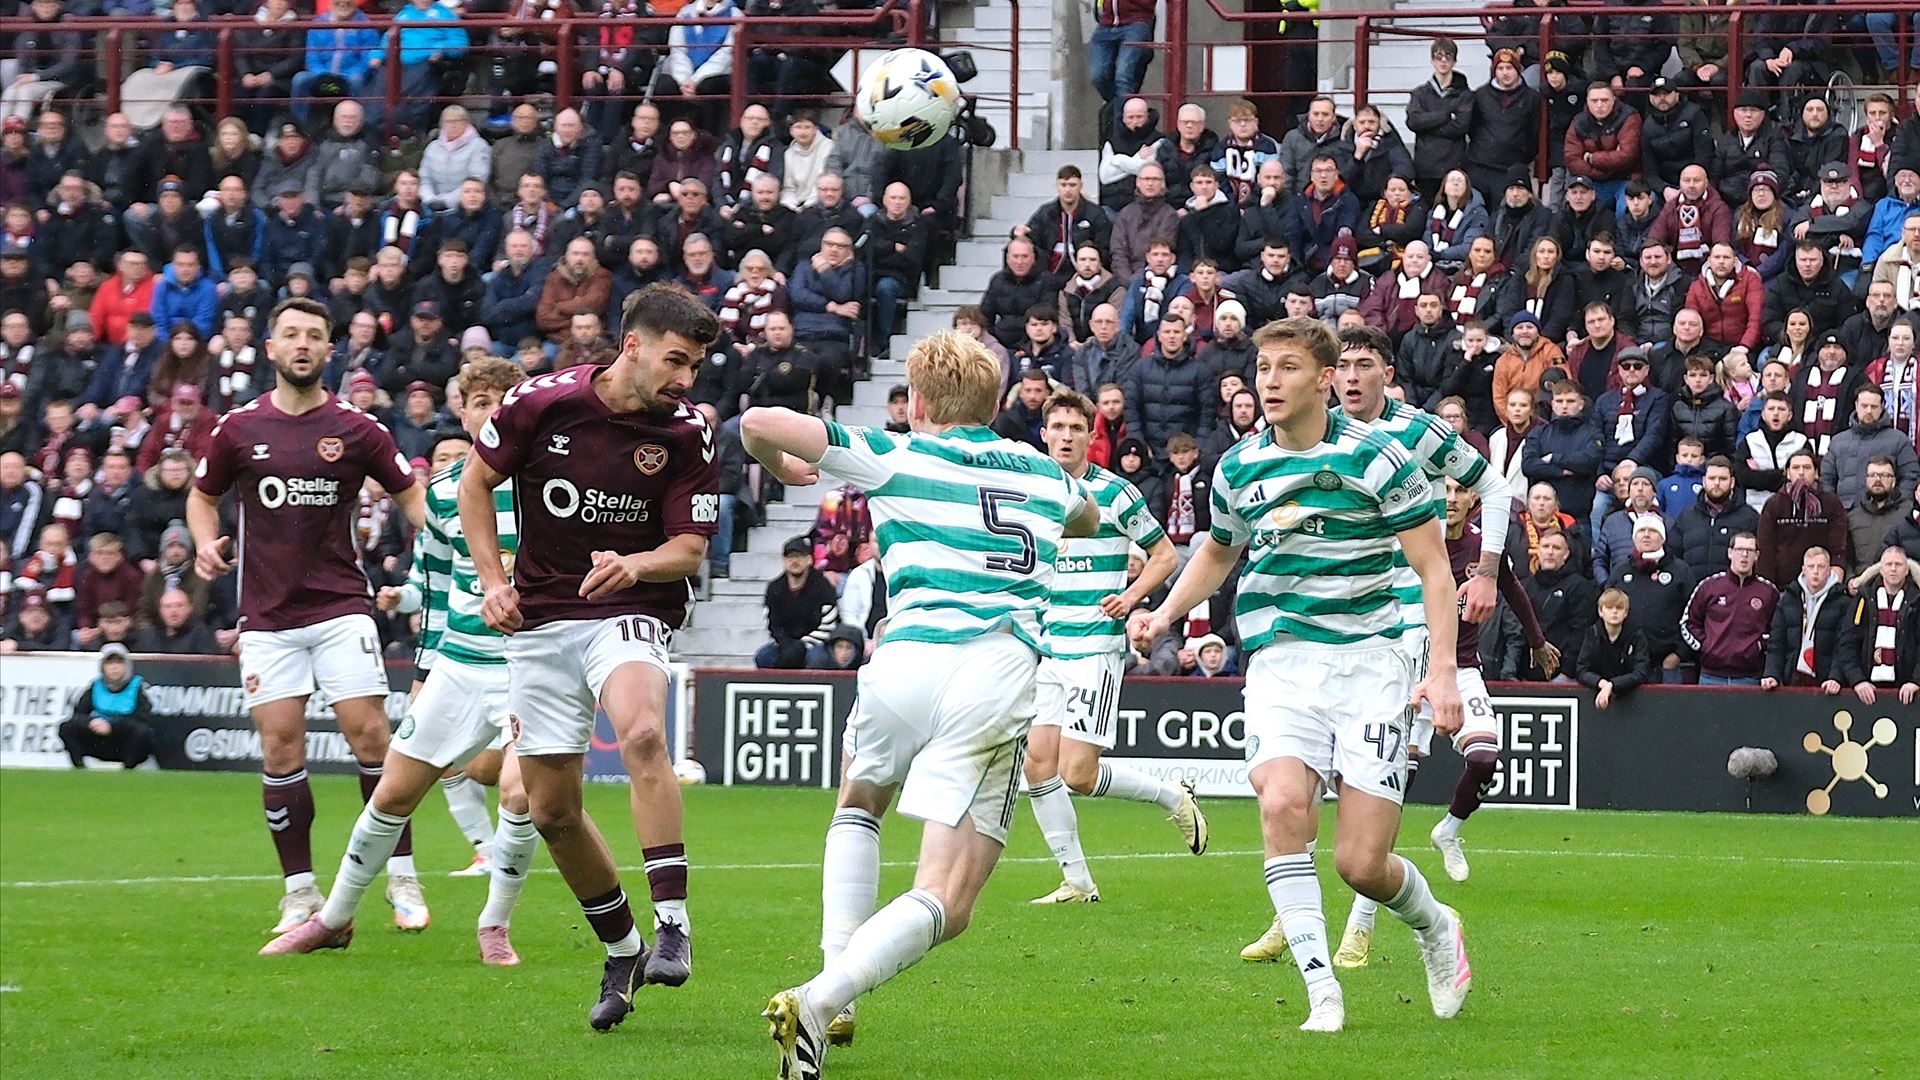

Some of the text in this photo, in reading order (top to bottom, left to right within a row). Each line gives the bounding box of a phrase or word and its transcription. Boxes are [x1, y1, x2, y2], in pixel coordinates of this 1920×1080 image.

[962, 449, 1032, 472] SCALES
[287, 477, 339, 492] Stellar
[287, 491, 338, 506] Omada
[584, 488, 652, 510] Stellar
[581, 506, 649, 524] Omada
[978, 485, 1037, 575] 5
[616, 617, 655, 645] 10
[360, 636, 379, 667] 4
[1066, 686, 1097, 717] 24
[739, 699, 818, 738] HEI
[1157, 710, 1246, 749] GRO
[1364, 722, 1402, 762] 47
[737, 742, 818, 781] GHT
